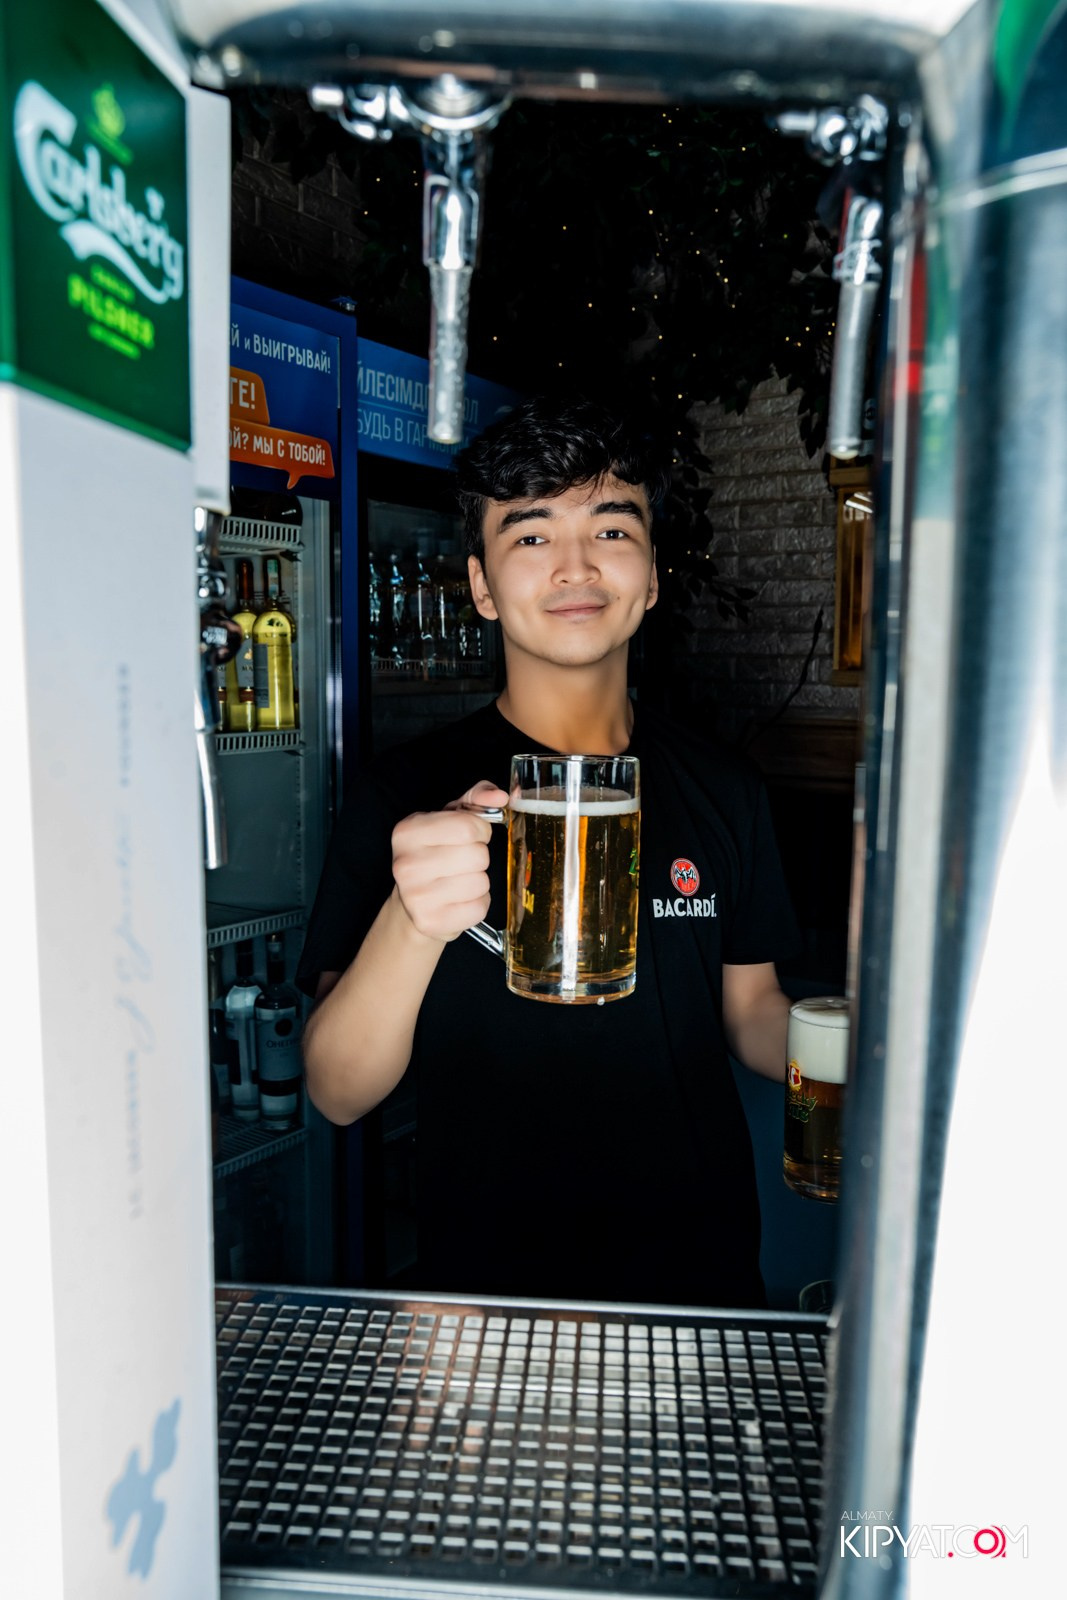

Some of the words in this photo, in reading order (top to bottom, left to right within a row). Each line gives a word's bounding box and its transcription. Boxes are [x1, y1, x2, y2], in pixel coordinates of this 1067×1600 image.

[13, 79, 183, 304] Carlsberg
[253, 334, 331, 374] ВЫИГРЫВАЙ!
[229, 377, 256, 410] ТЕ!
[394, 417, 404, 443] В
[253, 435, 273, 455] МЫ
[277, 439, 285, 458] С
[288, 441, 326, 466] ТОБОЙ!
